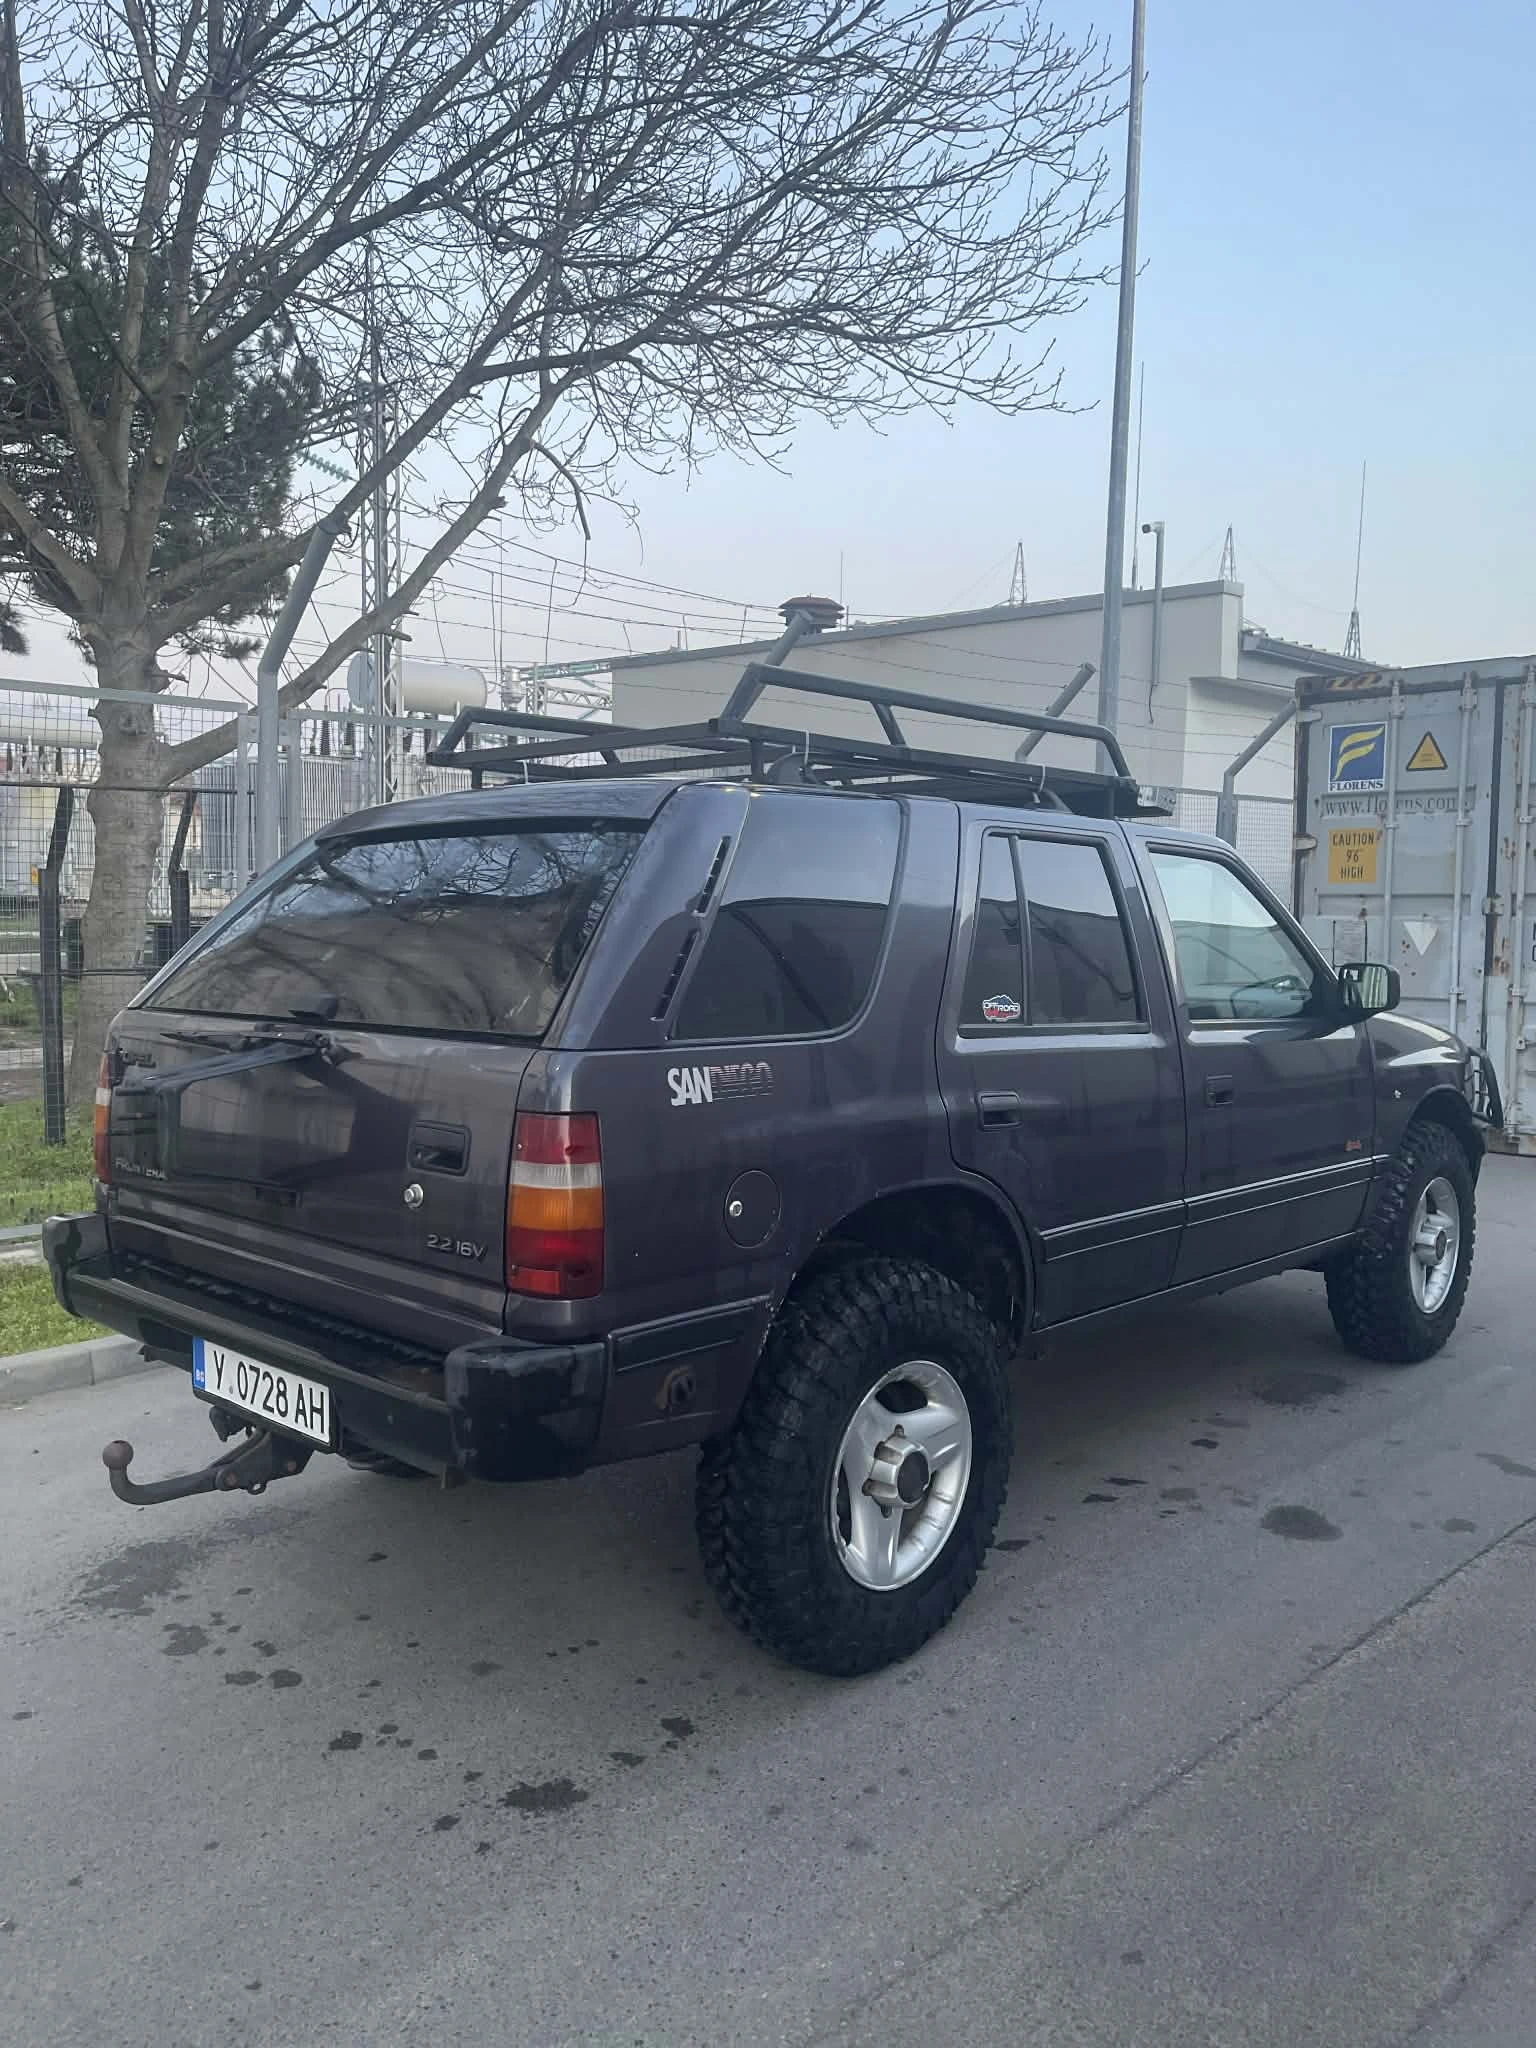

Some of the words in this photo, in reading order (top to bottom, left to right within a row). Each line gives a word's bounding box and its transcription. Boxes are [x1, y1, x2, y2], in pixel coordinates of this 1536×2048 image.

[1329, 779, 1384, 791] FLORENS
[1332, 832, 1375, 847] CAUTION
[1340, 865, 1363, 880] HIGH
[667, 1066, 713, 1106] SAN
[237, 1361, 289, 1418] 0728
[294, 1383, 325, 1434] AH
